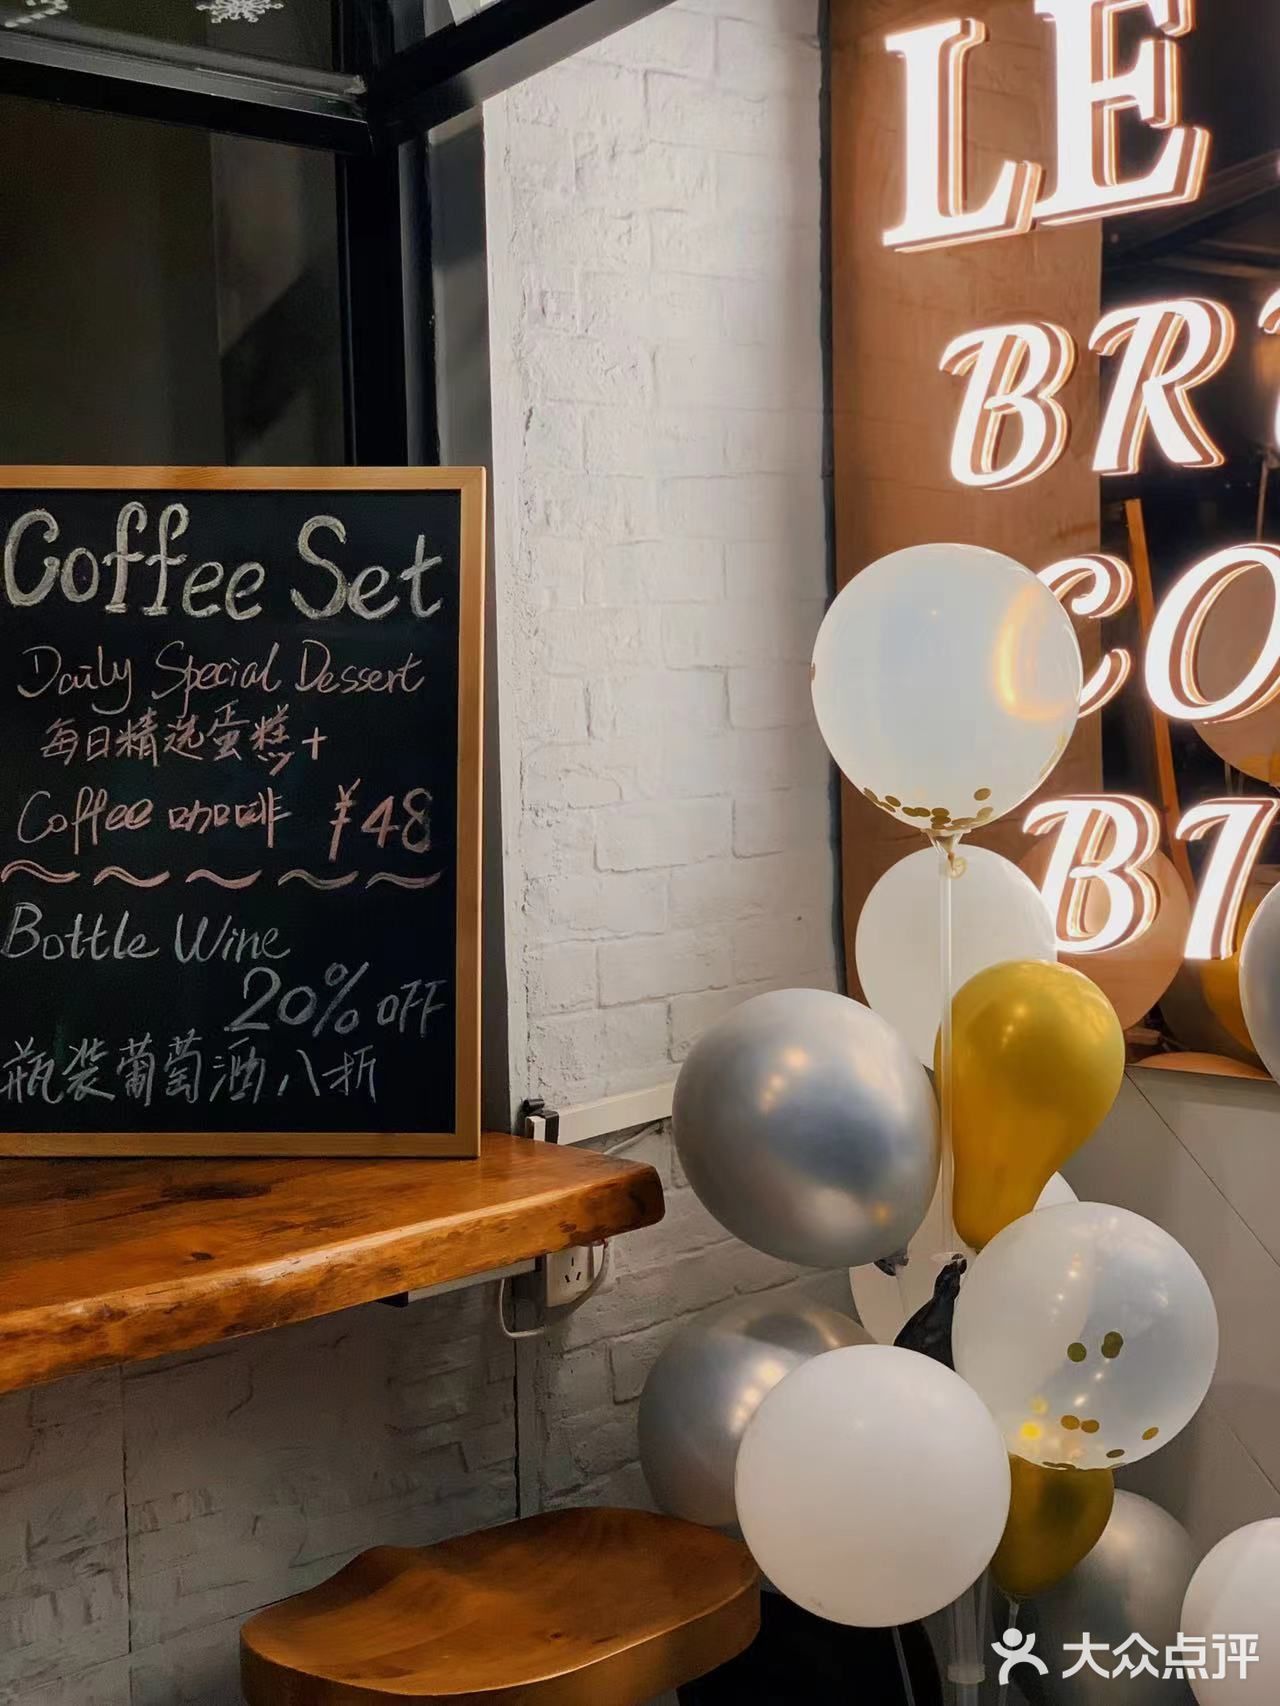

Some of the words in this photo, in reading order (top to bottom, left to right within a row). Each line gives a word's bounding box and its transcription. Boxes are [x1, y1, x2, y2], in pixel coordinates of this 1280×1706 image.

[882, 0, 1212, 253] LE
[4, 501, 267, 621] Coffee
[289, 514, 443, 620] Set
[17, 644, 133, 715] Daily
[151, 640, 283, 717] Special
[294, 638, 425, 695] Dessert
[17, 785, 153, 856] Coffee
[167, 786, 293, 849] 咖啡
[327, 777, 434, 862] ¥48
[0, 901, 161, 962] Bottle
[174, 912, 291, 964] Wine
[223, 961, 370, 1038] 20%
[0, 1027, 377, 1107] 瓶装葡萄酒八折
